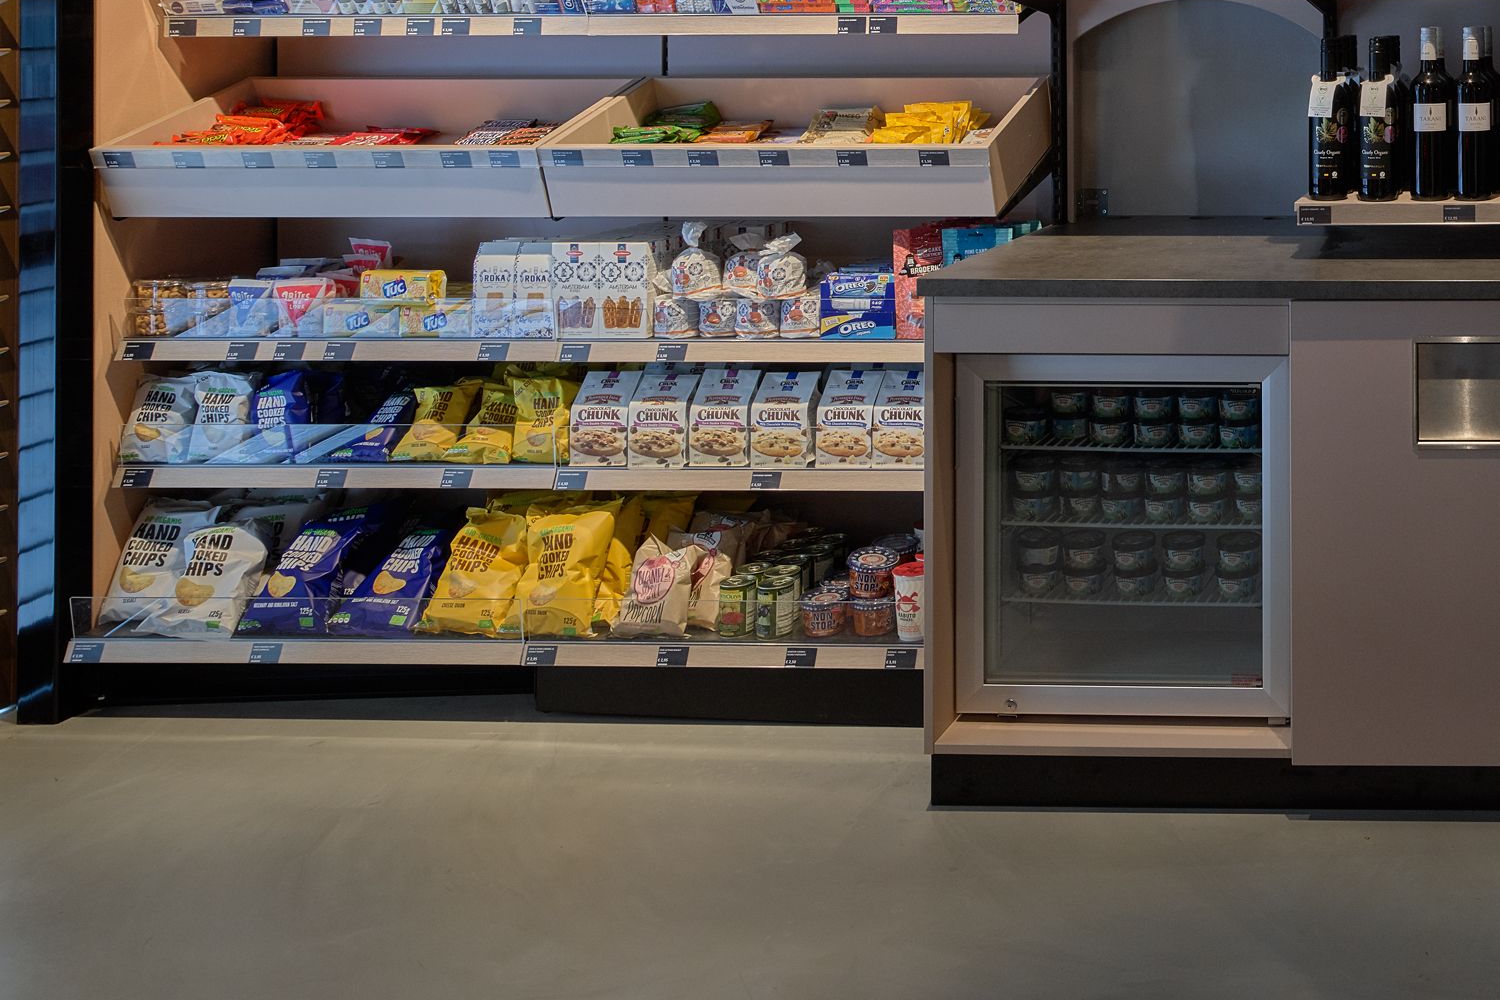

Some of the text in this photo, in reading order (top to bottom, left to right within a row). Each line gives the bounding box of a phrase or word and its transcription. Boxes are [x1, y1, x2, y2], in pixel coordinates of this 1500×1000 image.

[524, 275, 547, 283] ROKA
[383, 280, 406, 295] TUC
[835, 281, 864, 293] OREO
[348, 313, 369, 328] TUC
[425, 314, 447, 329] TUC
[839, 321, 876, 335] OREO
[146, 390, 176, 404] HAND
[202, 392, 235, 405] HAND
[257, 396, 287, 409] HAND
[141, 404, 172, 412] COOKED
[200, 405, 230, 414] COOKED
[257, 408, 285, 418] COOKED
[486, 402, 517, 416] HAND
[578, 408, 621, 421] CHUNK
[136, 412, 168, 423] CHIPS
[200, 414, 230, 424] CHIPS
[483, 412, 515, 424] COOKED
[636, 410, 679, 423] CHUNK
[697, 409, 741, 421] CHUNK
[758, 410, 800, 422] CHUNK
[824, 409, 866, 421] CHUNK
[881, 409, 921, 421] CHUNK
[257, 416, 286, 428] CHIPS
[132, 524, 182, 542] HAND
[128, 539, 174, 552] COOKED
[290, 534, 333, 553] HAND
[399, 534, 435, 549] HAND
[455, 535, 500, 560] HAND
[122, 552, 168, 567] CHIPS
[390, 547, 425, 560] COOKED
[452, 548, 494, 565] COOKED
[184, 562, 224, 576] HIPS
[381, 558, 420, 574] CHIPS
[449, 558, 490, 573] CHIPS
[537, 563, 567, 581] CHIPS
[857, 573, 877, 584] NON
[854, 581, 880, 592] STOP!
[623, 603, 664, 624] POPCORN
[813, 612, 833, 621] NON
[563, 616, 577, 626] 125g
[810, 620, 836, 630] STOP!
